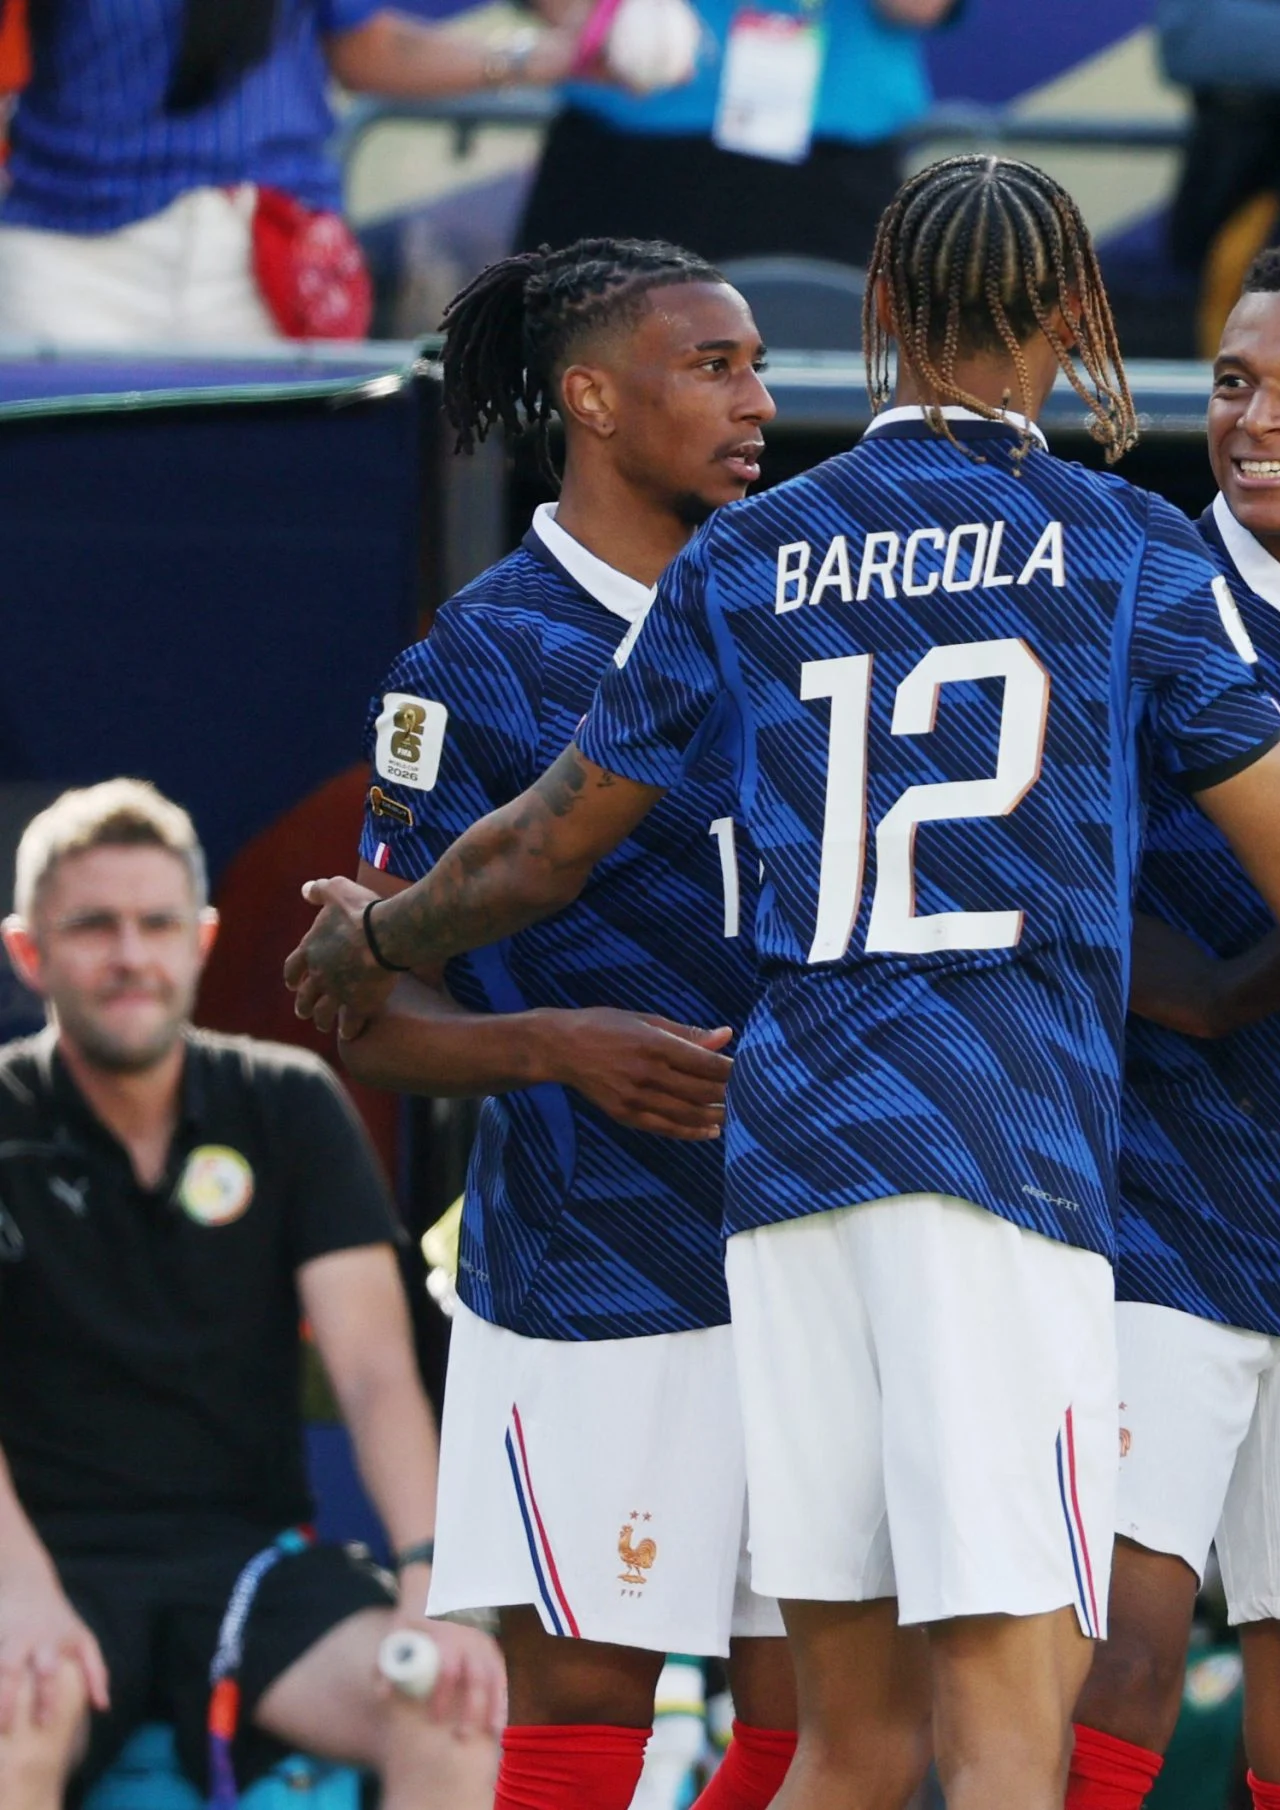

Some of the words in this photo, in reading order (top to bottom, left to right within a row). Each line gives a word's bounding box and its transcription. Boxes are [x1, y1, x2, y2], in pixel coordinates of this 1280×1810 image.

[775, 520, 1066, 615] BARCOLA
[397, 747, 412, 758] FIFA
[387, 765, 418, 780] 2026
[800, 637, 1051, 964] 12
[1022, 1184, 1080, 1212] AERO-FIT
